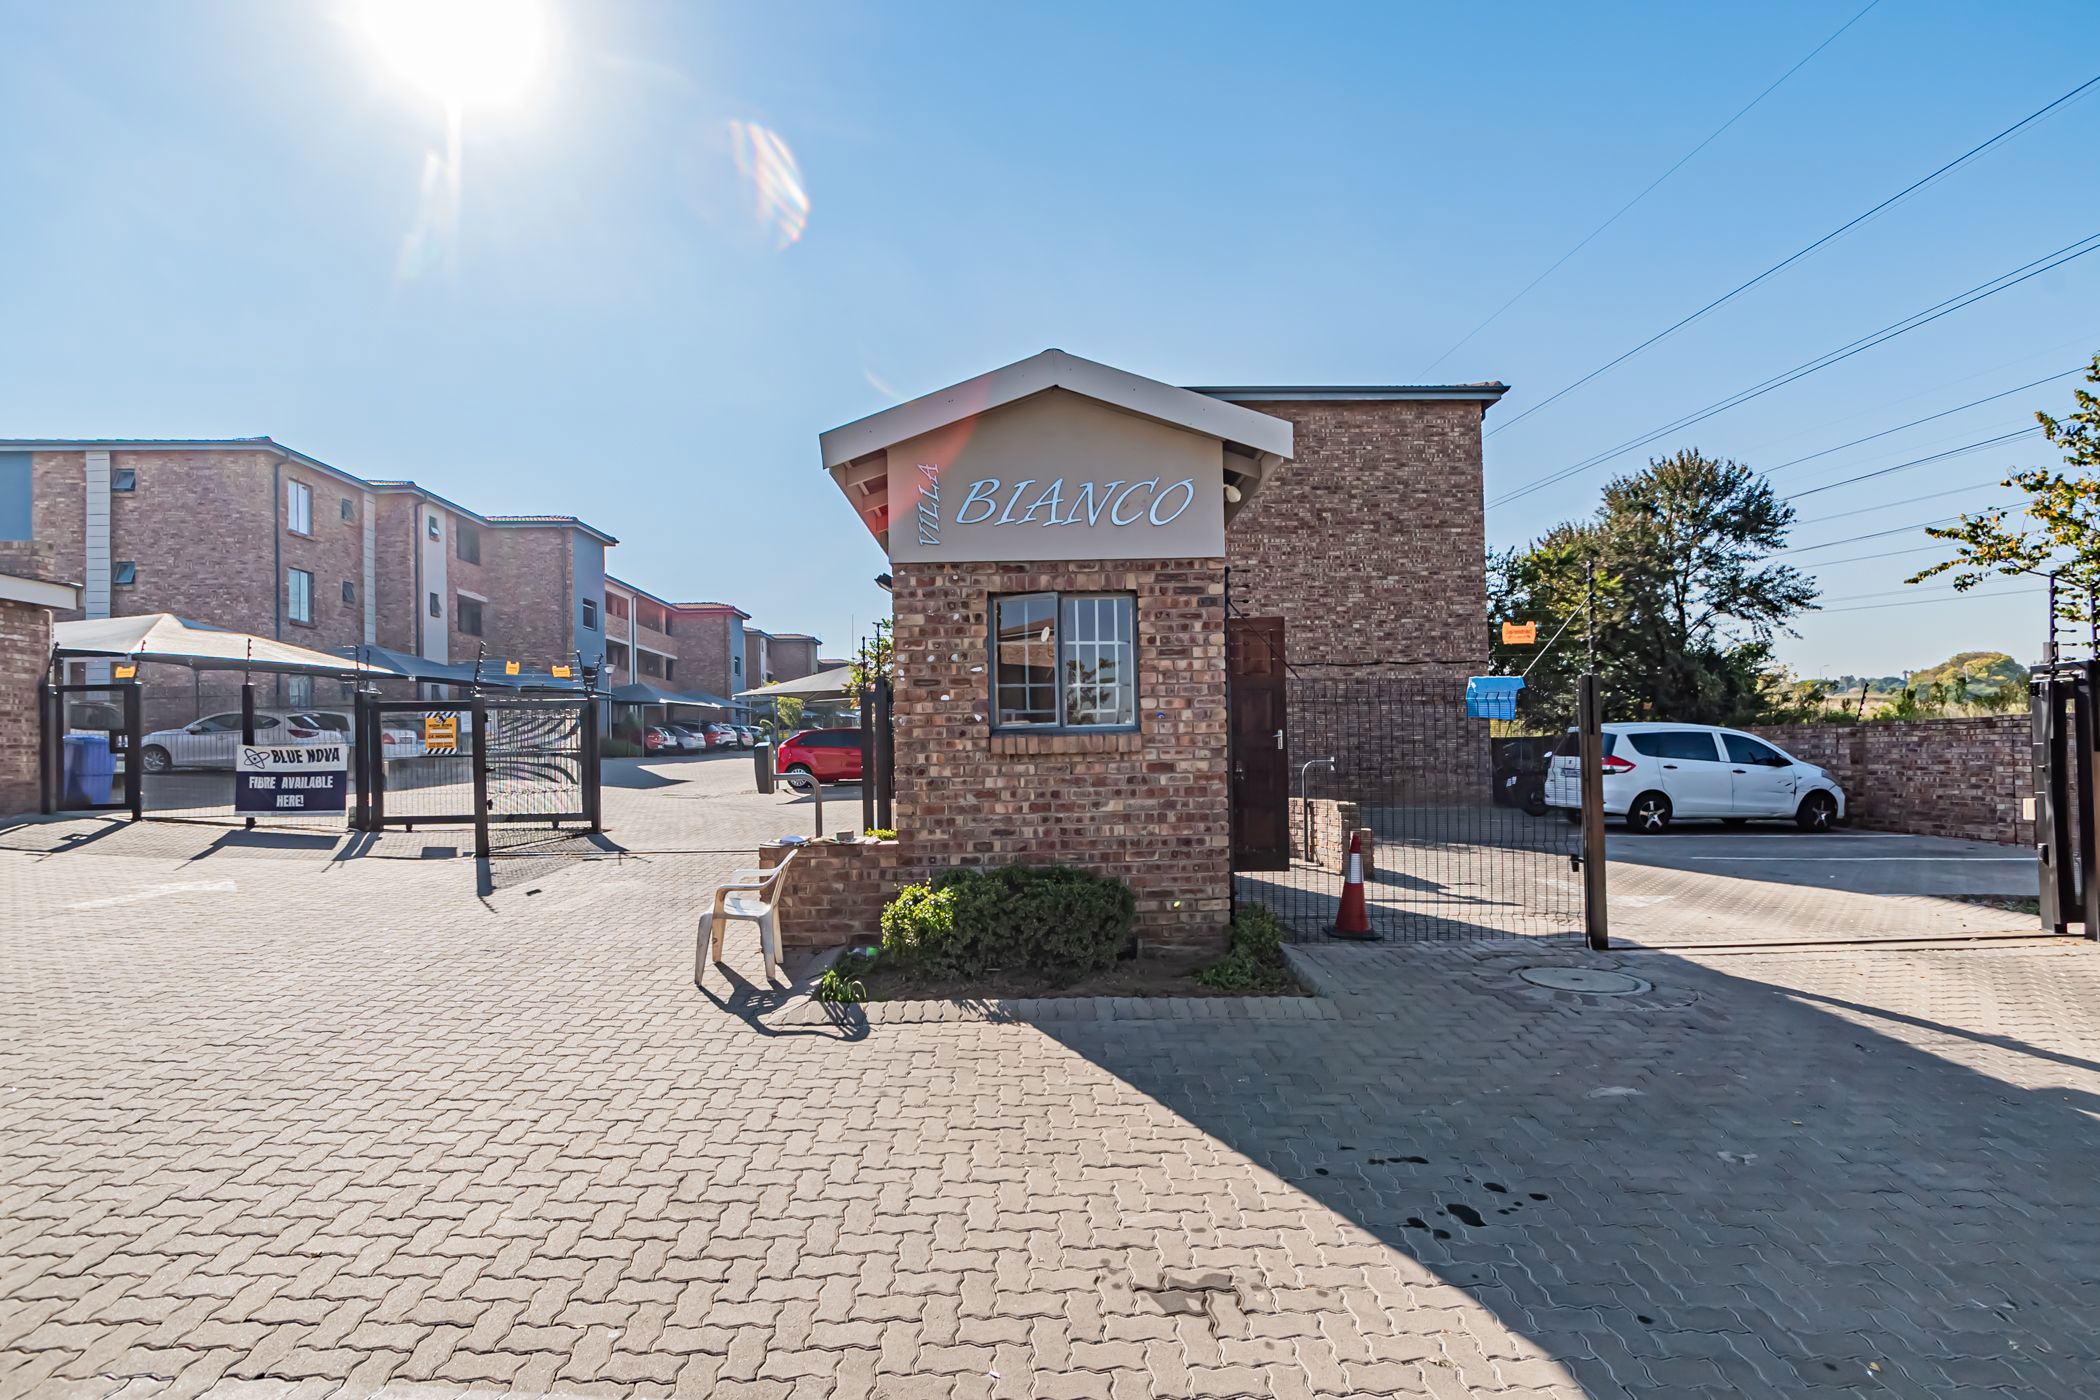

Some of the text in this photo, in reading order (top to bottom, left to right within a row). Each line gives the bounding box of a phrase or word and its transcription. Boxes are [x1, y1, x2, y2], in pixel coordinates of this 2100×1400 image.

[917, 463, 941, 546] VILLA
[955, 476, 1195, 528] BIANCO
[272, 747, 340, 764] BLUE NOVA
[249, 775, 334, 789] FIBRE AVAILABLE
[276, 794, 305, 808] HERE!
